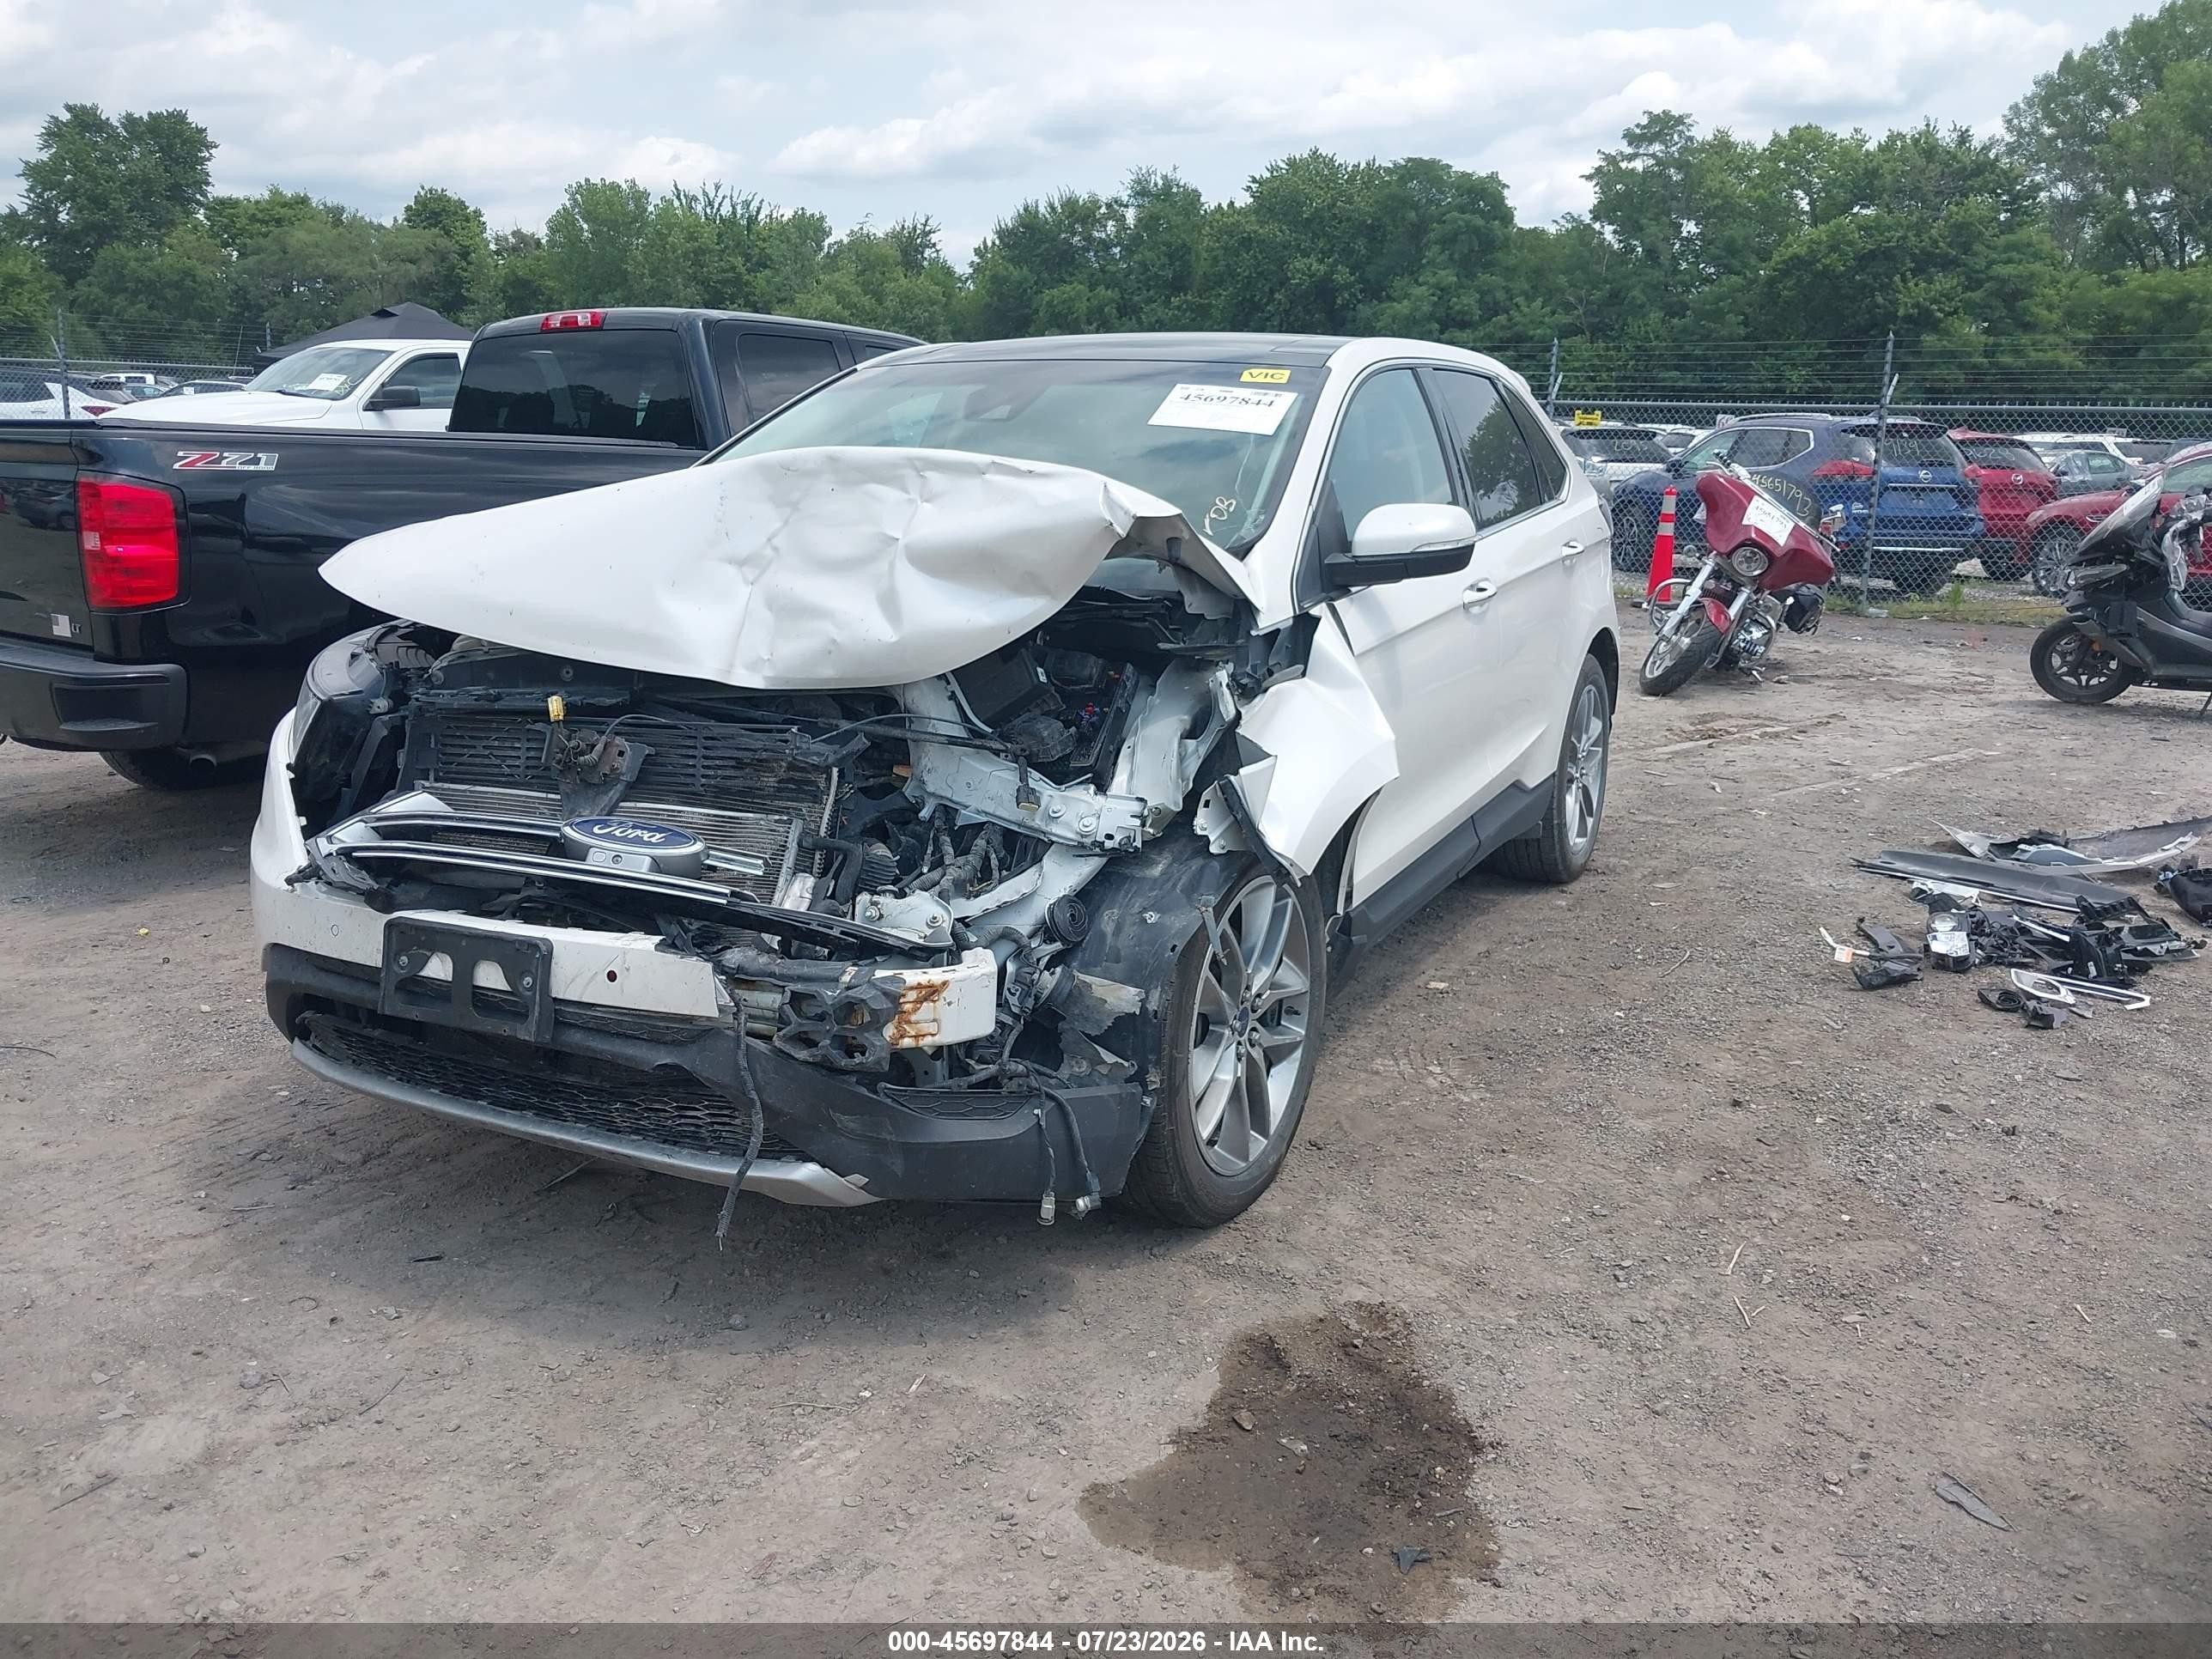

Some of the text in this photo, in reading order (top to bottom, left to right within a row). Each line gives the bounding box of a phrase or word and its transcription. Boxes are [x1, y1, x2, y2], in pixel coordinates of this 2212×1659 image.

[1248, 371, 1285, 380] VIC
[1180, 392, 1275, 408] 45697844
[172, 451, 279, 471] Z71
[1751, 473, 1813, 516] 45651793
[592, 819, 673, 844] Ford
